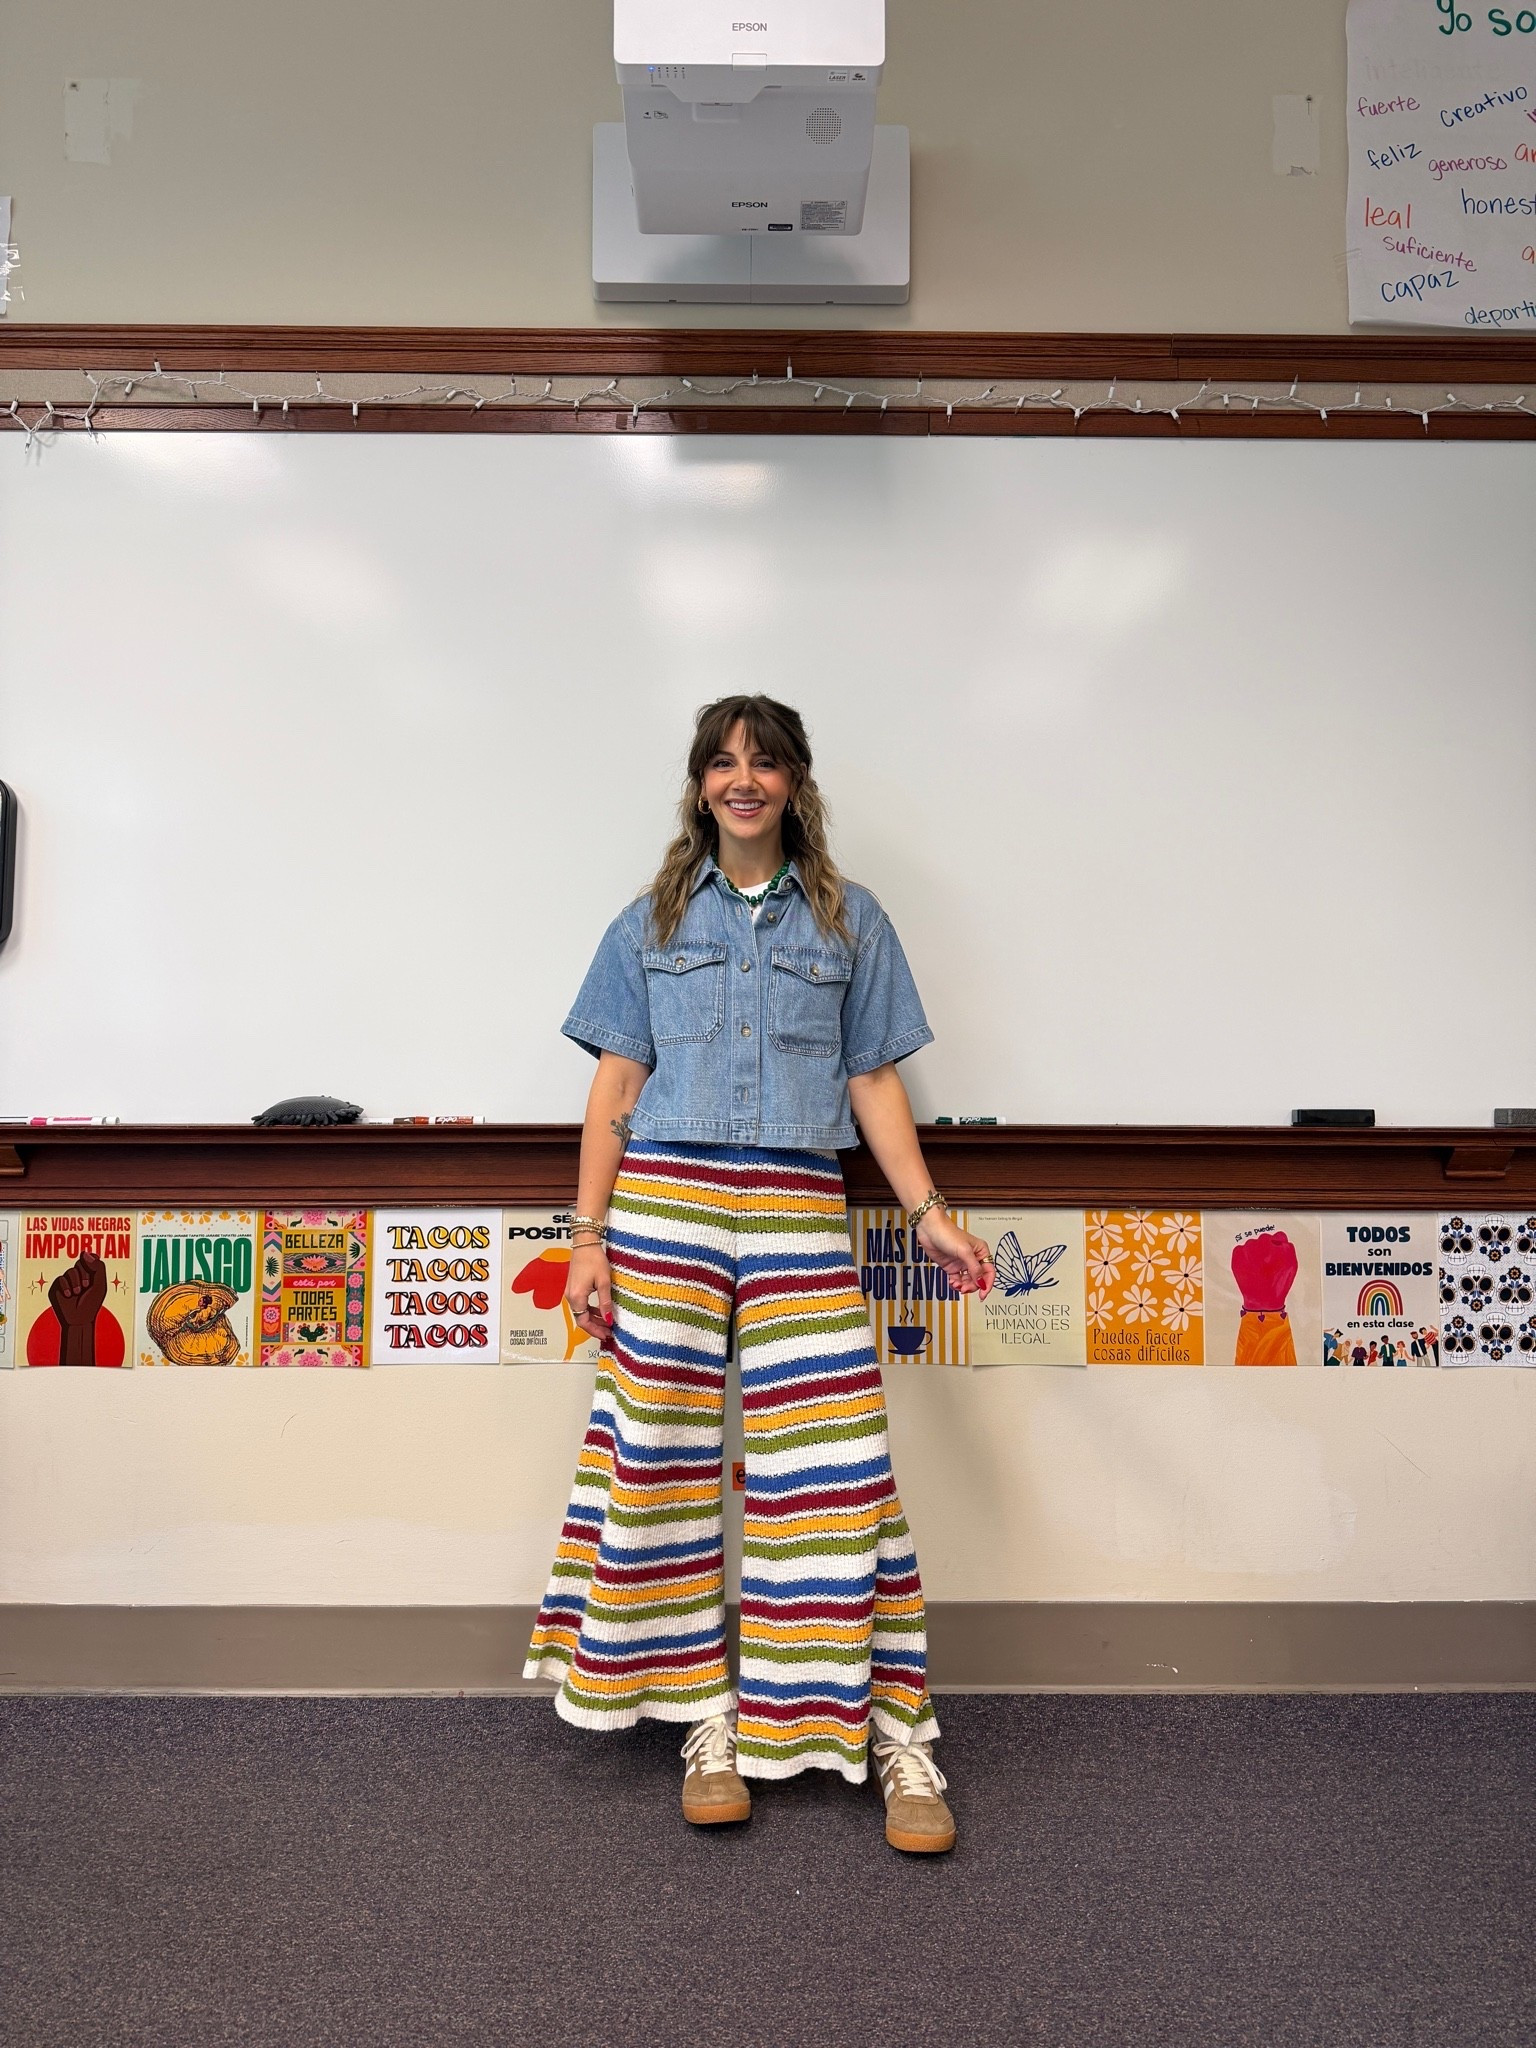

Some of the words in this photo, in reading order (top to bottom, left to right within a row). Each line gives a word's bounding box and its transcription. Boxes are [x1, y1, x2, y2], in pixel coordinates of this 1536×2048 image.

[732, 22, 767, 32] EPSON
[1357, 96, 1420, 117] fuerte
[1367, 143, 1422, 169] feliz
[1428, 155, 1507, 181] generoso
[1364, 197, 1411, 229] leal
[26, 1217, 48, 1231] LAS
[51, 1217, 84, 1231] VIDAS
[88, 1217, 131, 1231] NEGRAS
[552, 1212, 572, 1223] SÉ
[387, 1226, 490, 1250] TACOS
[509, 1227, 572, 1240] POSIT
[1346, 1226, 1411, 1243] TODOS
[25, 1233, 131, 1259] IMPORTAN
[285, 1234, 344, 1249] BELLEZA
[867, 1220, 905, 1263] MÁS
[1367, 1248, 1392, 1257] son
[140, 1238, 252, 1293] JALISCO
[386, 1258, 490, 1282] TACOS
[1325, 1262, 1433, 1276] BIENVENIDOS
[293, 1278, 315, 1287] está
[316, 1280, 336, 1289] por
[861, 1265, 897, 1301] POR
[293, 1291, 333, 1305] TODAS
[385, 1291, 489, 1316] TACOS
[288, 1306, 337, 1321] PARTES
[984, 1302, 1038, 1316] NINGÚN
[1041, 1304, 1070, 1316] SER
[986, 1318, 1047, 1330] HUMANO
[1051, 1318, 1070, 1330] ES
[1363, 1319, 1385, 1328] esta
[1388, 1318, 1414, 1328] clase
[384, 1324, 488, 1348] TACOS
[510, 1329, 527, 1338] PUEDES
[528, 1329, 544, 1337] HACER
[510, 1338, 525, 1346] COSAS
[526, 1336, 548, 1346] DIFÍCILES
[1001, 1332, 1051, 1345] ILEGAL
[1093, 1328, 1140, 1345] Puedes
[1146, 1328, 1183, 1345] hacer
[1093, 1348, 1131, 1361] cosas
[1137, 1345, 1190, 1362] difíciles
